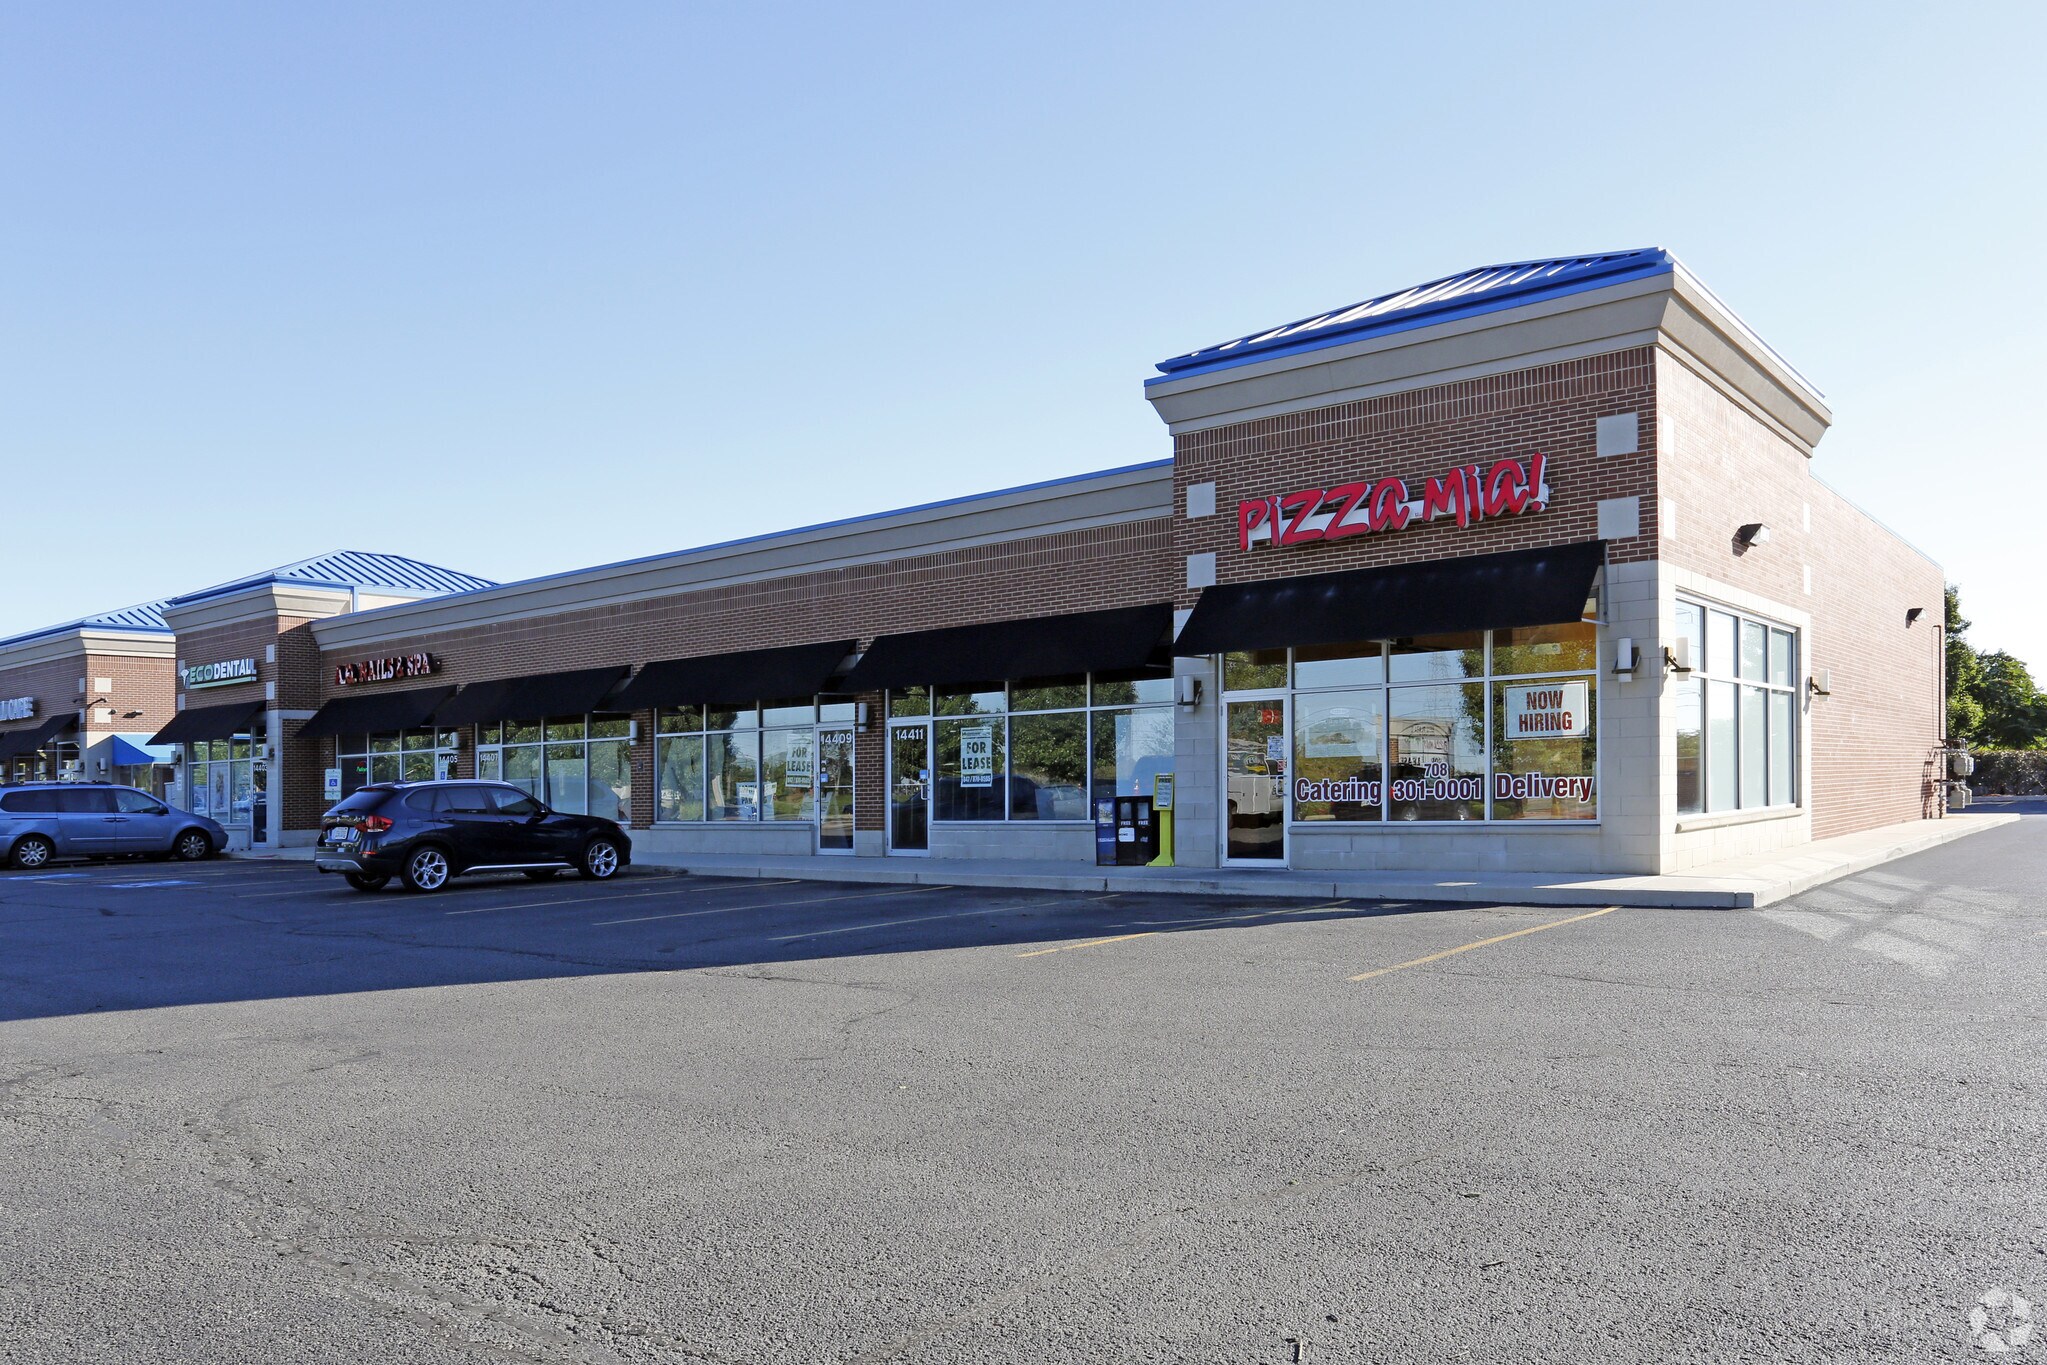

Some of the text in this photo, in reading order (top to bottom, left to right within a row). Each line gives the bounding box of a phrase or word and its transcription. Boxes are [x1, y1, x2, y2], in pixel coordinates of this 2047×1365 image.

[359, 658, 394, 682] NAILS
[396, 656, 405, 679] &
[407, 653, 431, 676] SPA
[1526, 690, 1563, 710] NOW
[1518, 711, 1573, 732] HIRING
[820, 733, 852, 744] 14409
[896, 729, 924, 740] 14411
[792, 747, 807, 758] FOR
[966, 741, 986, 754] FOR
[440, 755, 458, 763] 14405
[962, 757, 991, 770] LEASE
[787, 761, 812, 772] LEASE
[1424, 762, 1449, 778] 708
[1296, 772, 1594, 806] Catering 301-0001 Delivery
